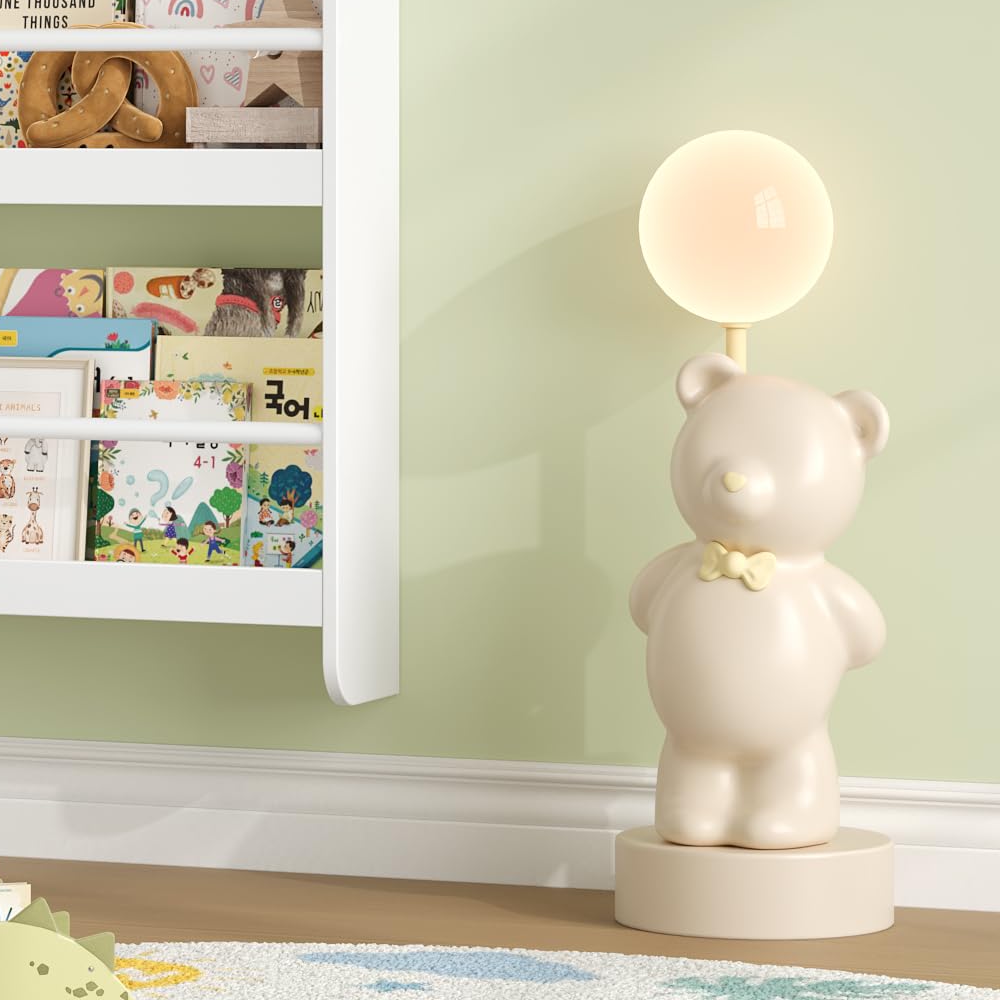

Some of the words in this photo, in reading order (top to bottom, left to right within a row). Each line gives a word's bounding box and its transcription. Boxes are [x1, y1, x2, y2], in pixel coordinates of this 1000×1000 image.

[22, 15, 68, 29] THINGS
[264, 380, 310, 419] 국어
[5, 403, 41, 412] ANIMALS
[193, 455, 215, 468] 4-1
